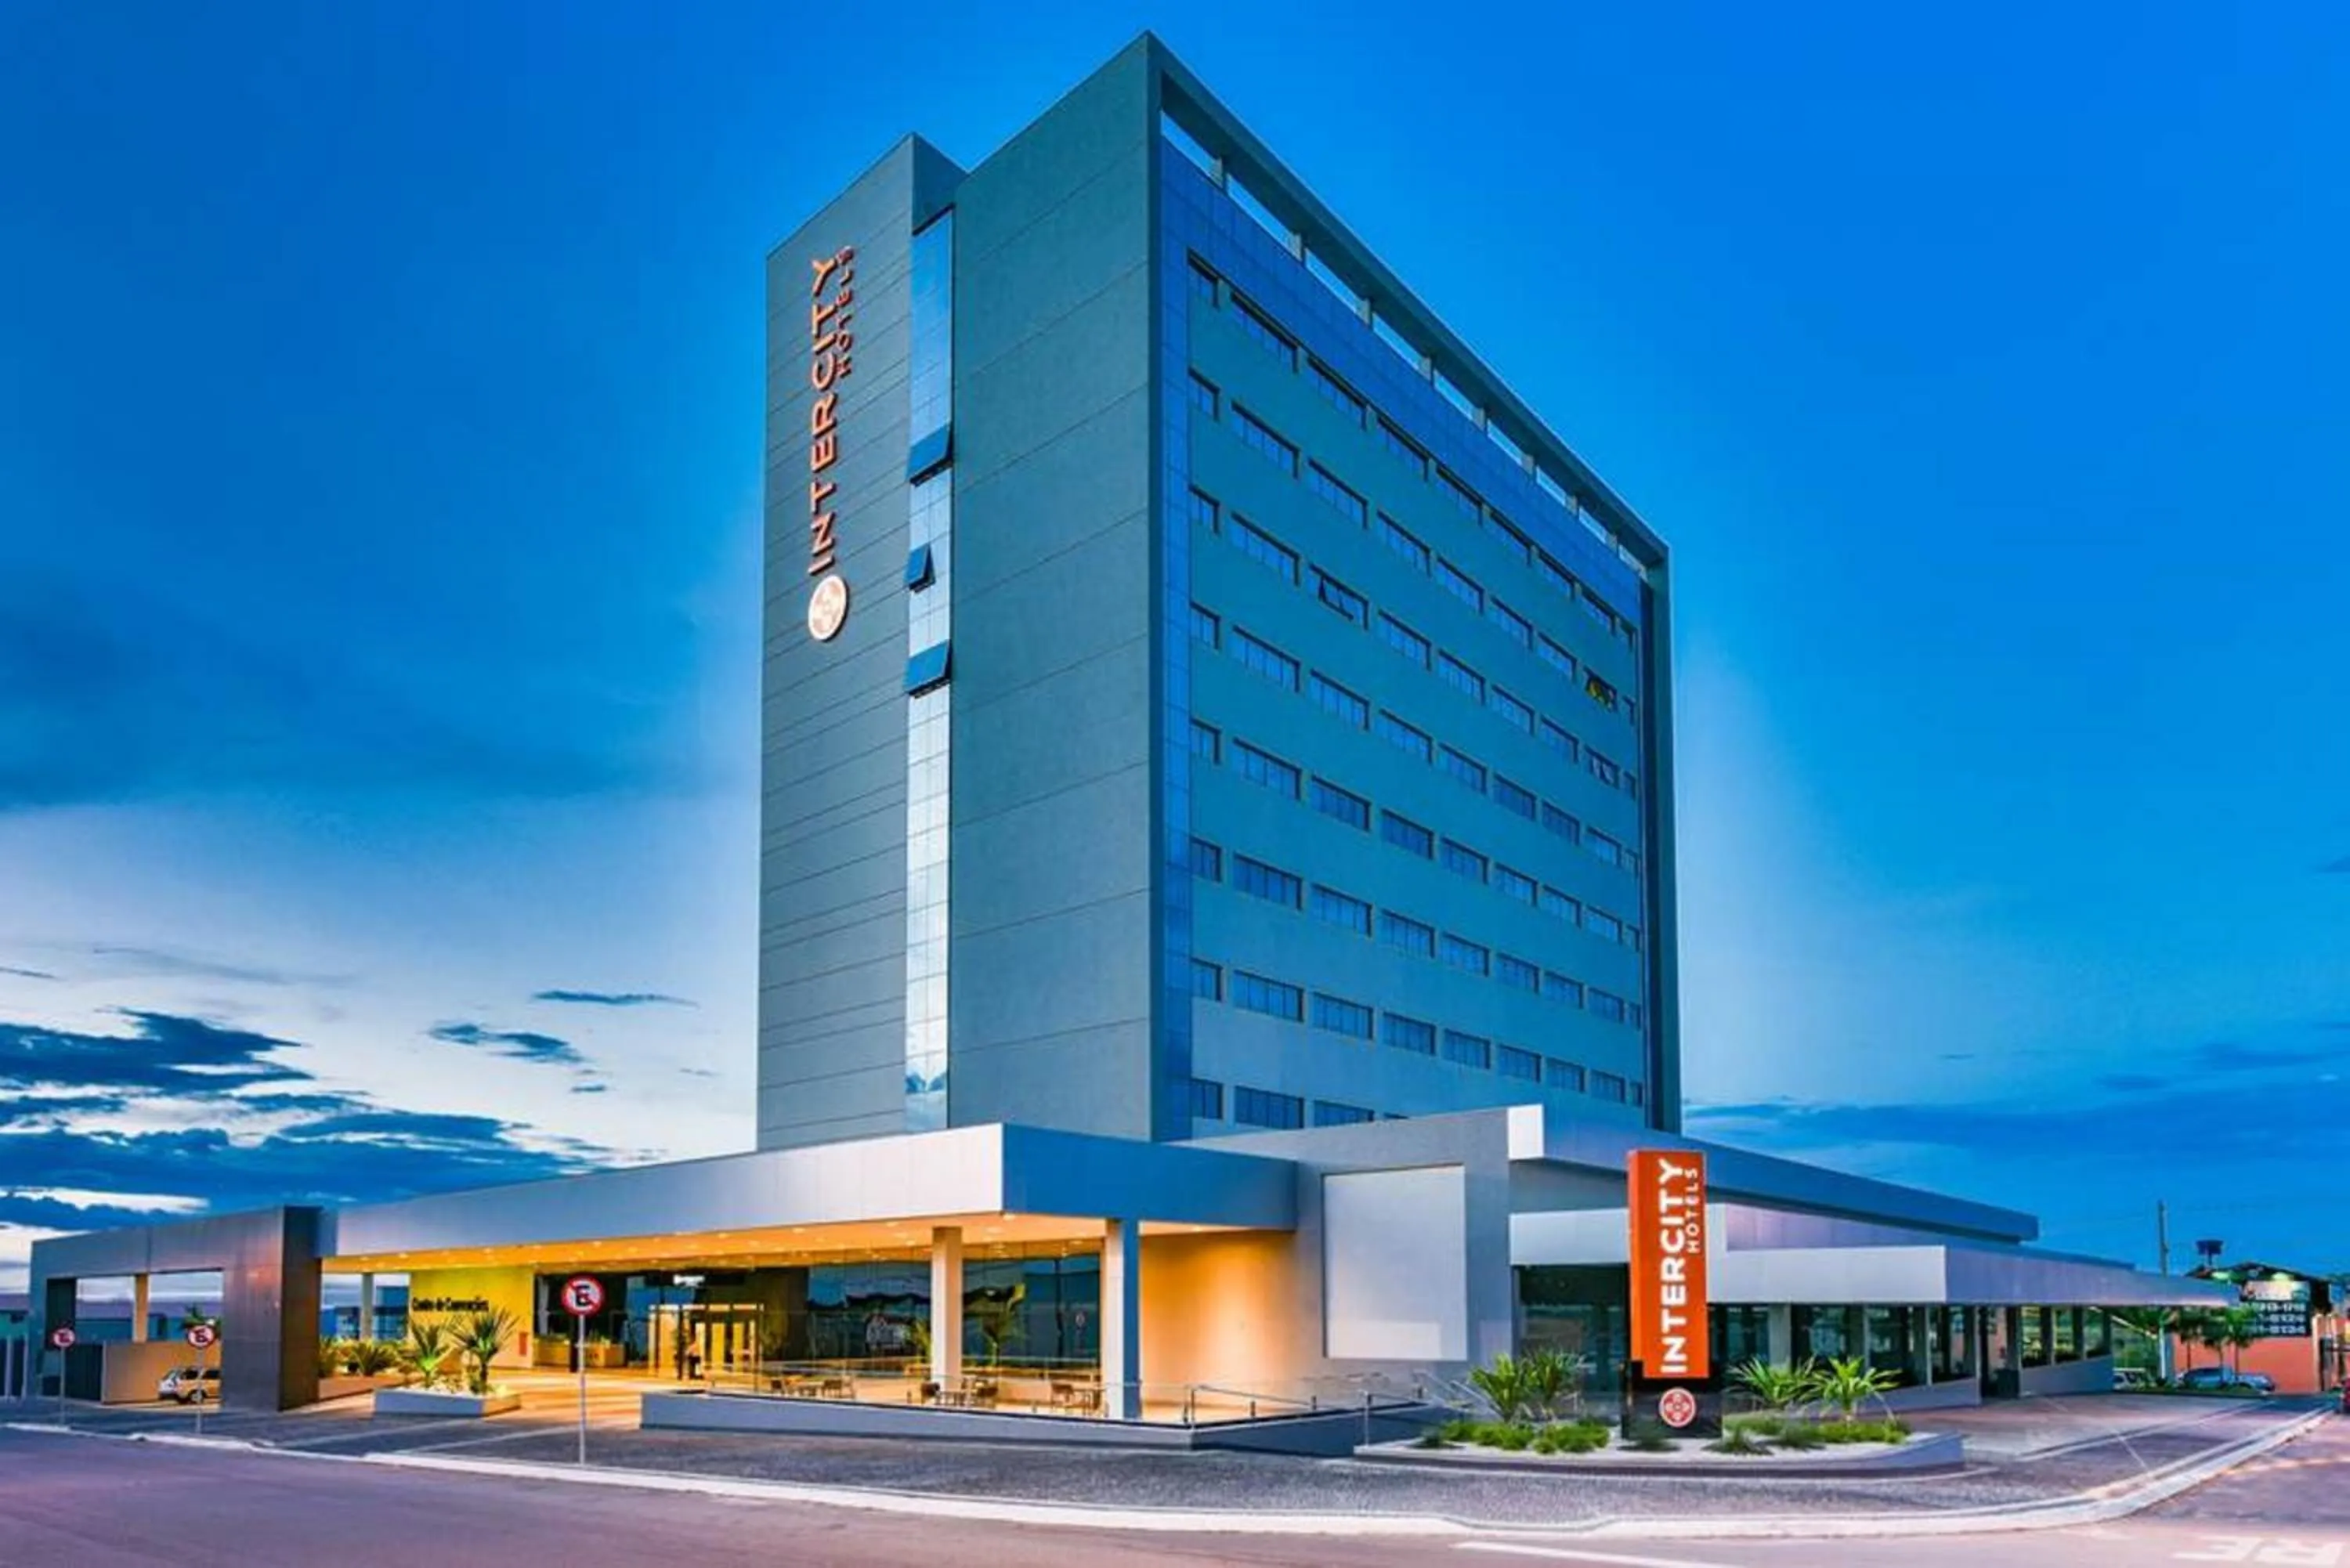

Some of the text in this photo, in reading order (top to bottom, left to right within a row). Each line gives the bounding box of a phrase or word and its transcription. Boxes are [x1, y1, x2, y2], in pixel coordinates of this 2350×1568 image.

[835, 245, 855, 378] HOTELS
[808, 258, 838, 576] INTERCITY
[1658, 1158, 1687, 1374] INTERCITY
[1685, 1167, 1701, 1254] HOTELS
